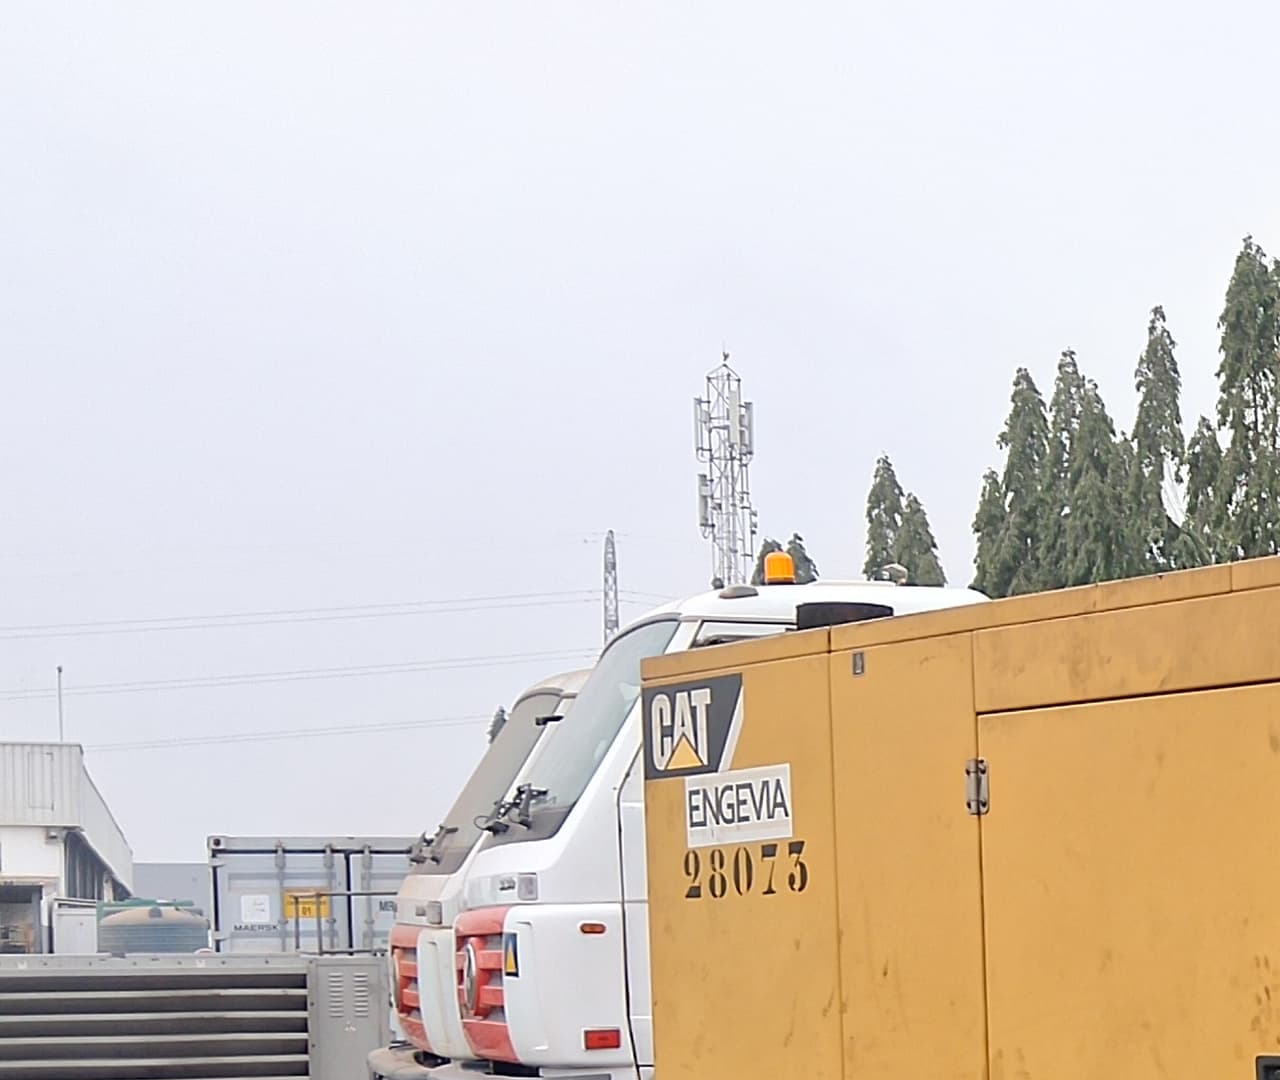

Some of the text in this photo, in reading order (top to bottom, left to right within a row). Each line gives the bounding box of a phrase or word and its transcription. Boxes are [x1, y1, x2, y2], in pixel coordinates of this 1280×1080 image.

[651, 688, 711, 771] CAT
[688, 778, 789, 828] ENGEVIA
[684, 841, 808, 898] 28073
